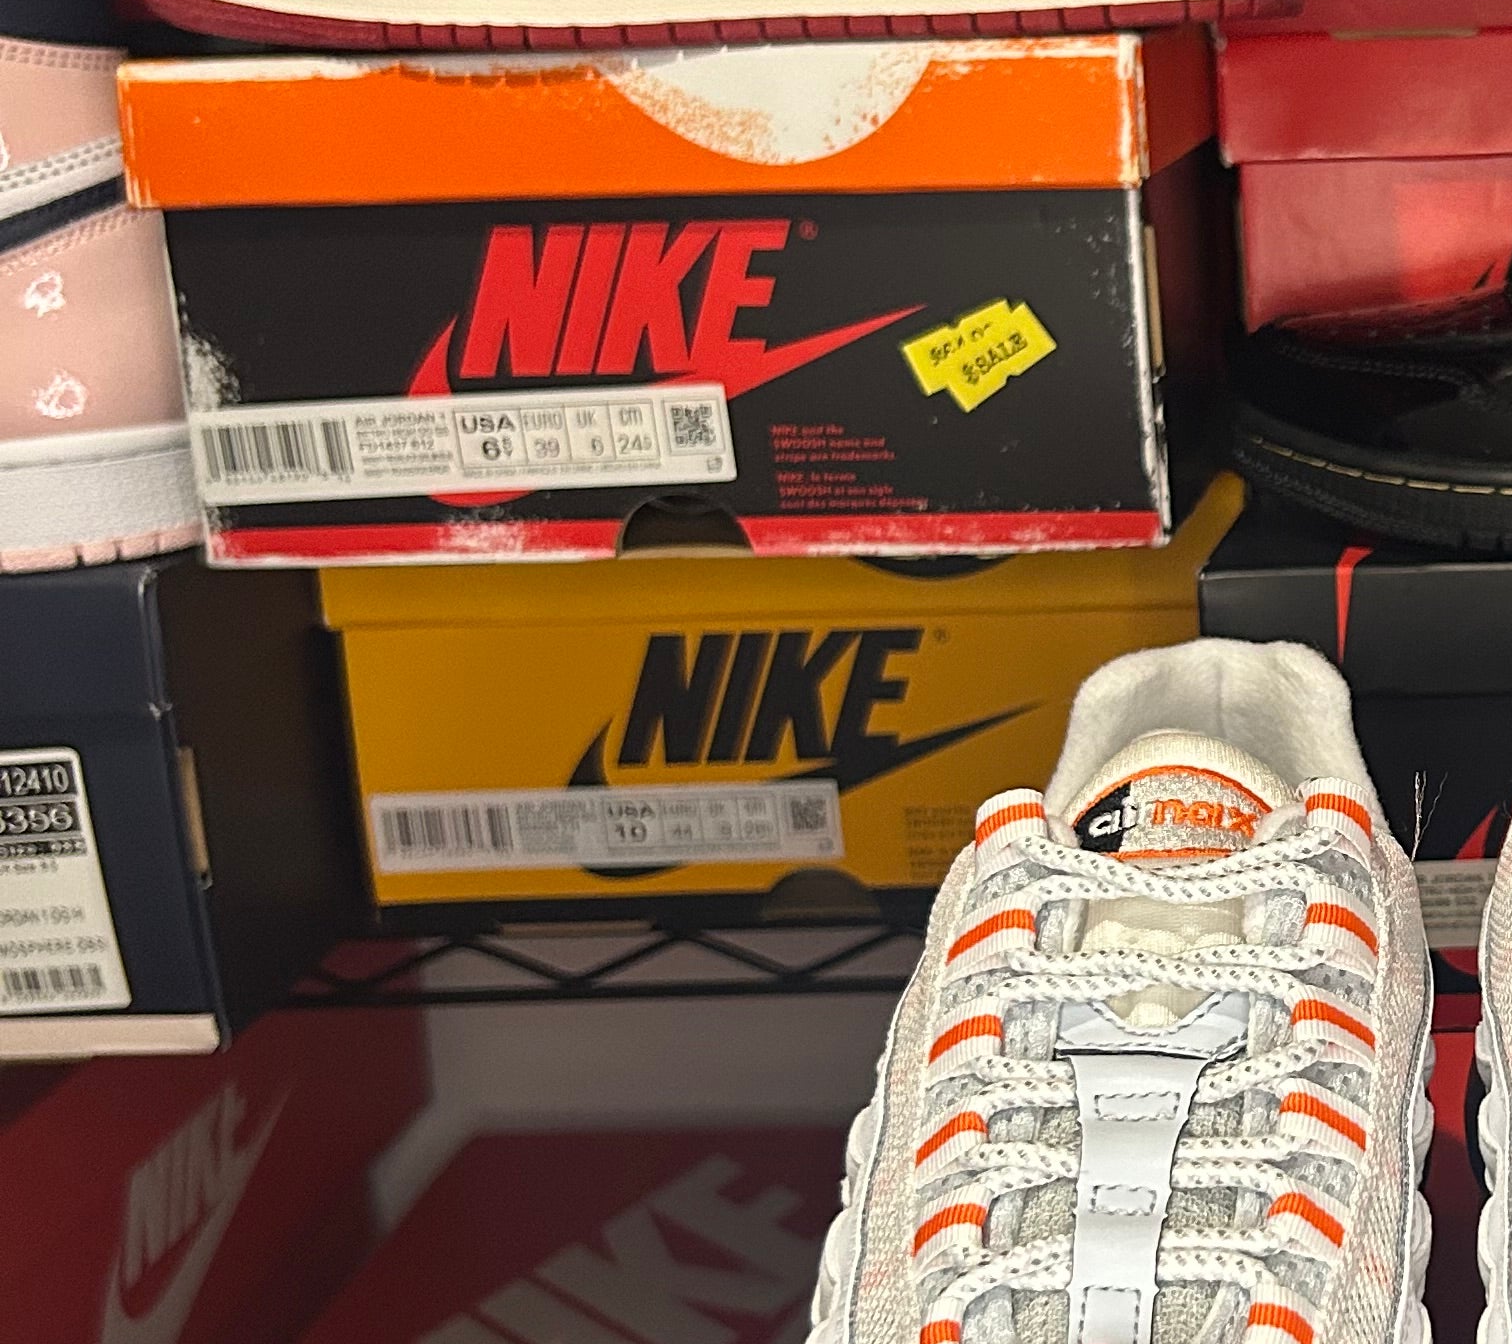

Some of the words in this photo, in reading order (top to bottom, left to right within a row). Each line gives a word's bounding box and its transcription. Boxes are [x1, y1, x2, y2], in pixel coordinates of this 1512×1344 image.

[459, 219, 793, 380] NIKE
[461, 414, 516, 434] USA
[617, 627, 925, 766] NIKE
